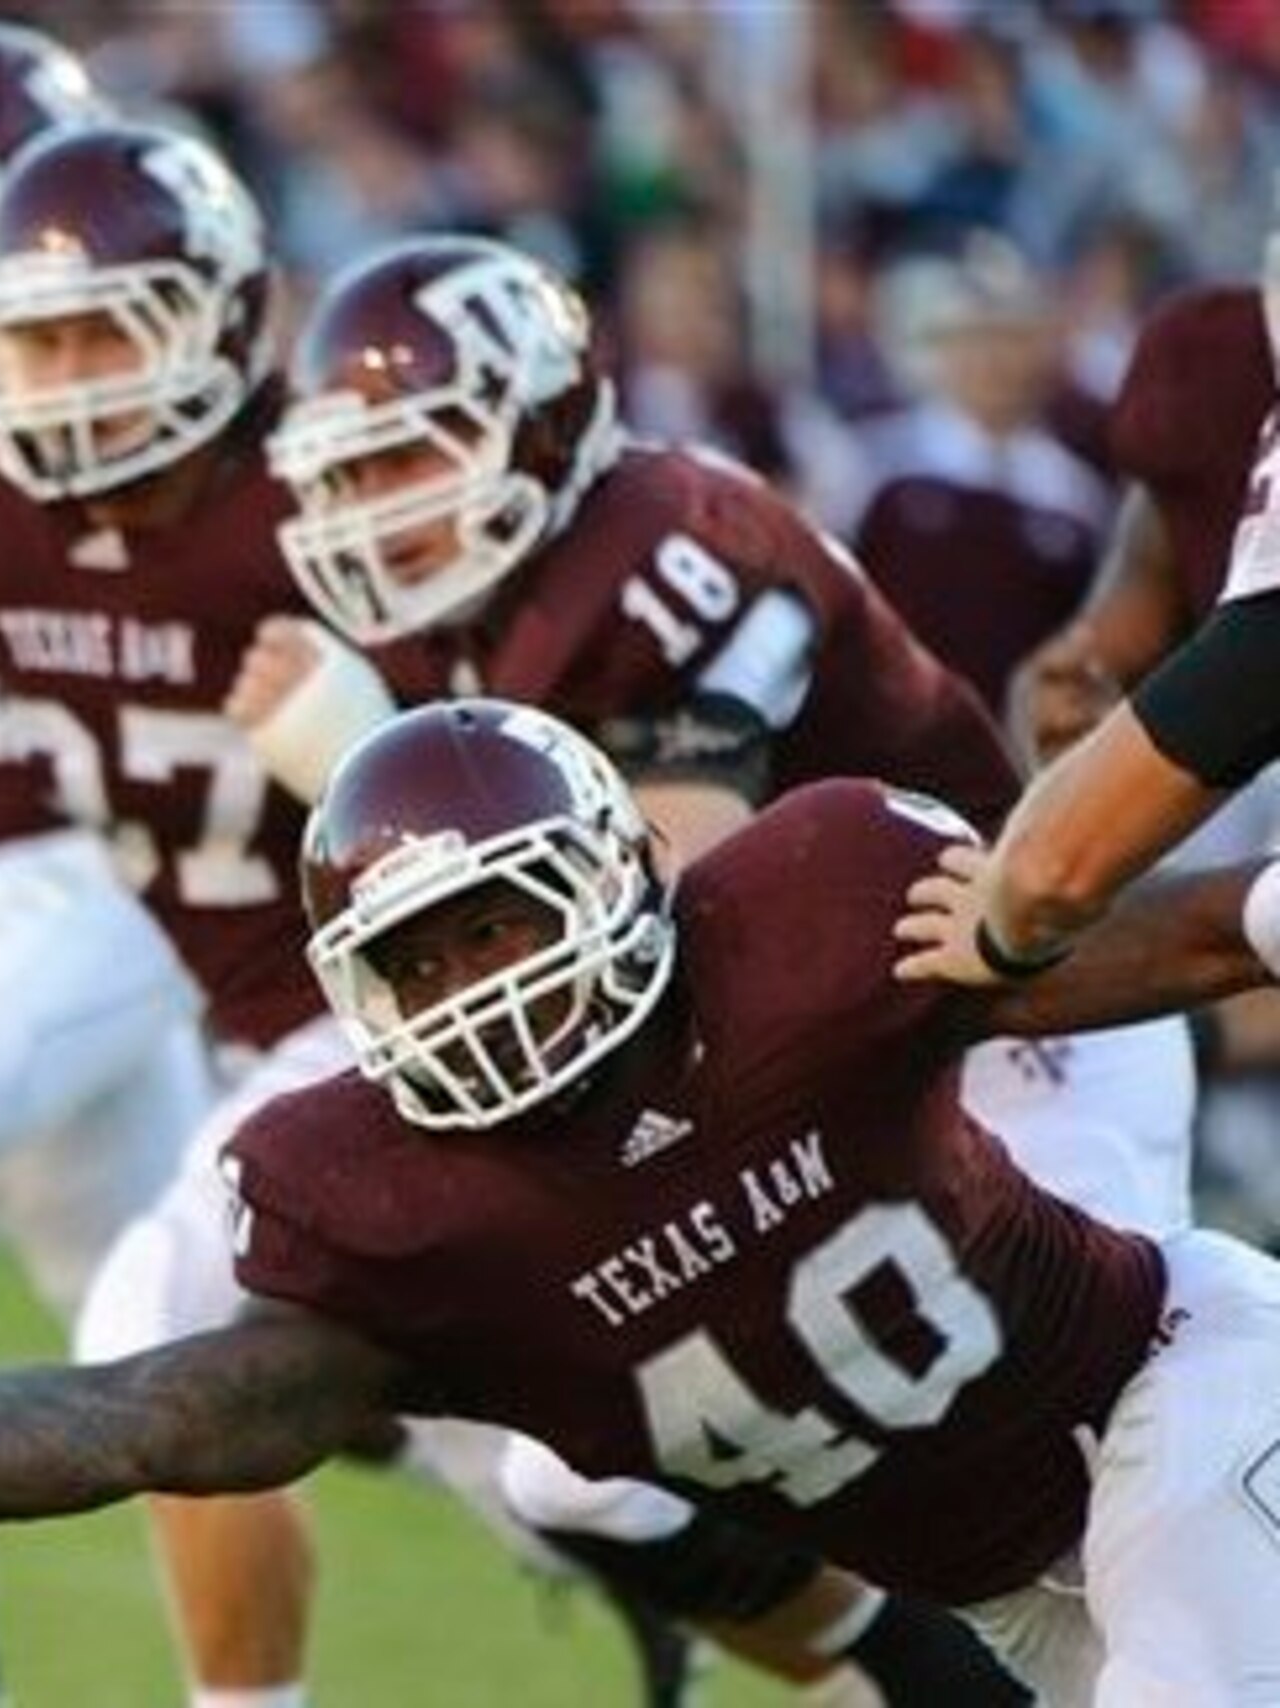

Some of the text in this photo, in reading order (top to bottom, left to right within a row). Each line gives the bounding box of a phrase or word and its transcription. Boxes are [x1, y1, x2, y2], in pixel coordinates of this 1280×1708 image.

[621, 532, 738, 666] 18
[569, 1129, 835, 1327] TEXAS A&M
[632, 1200, 1004, 1509] 40
